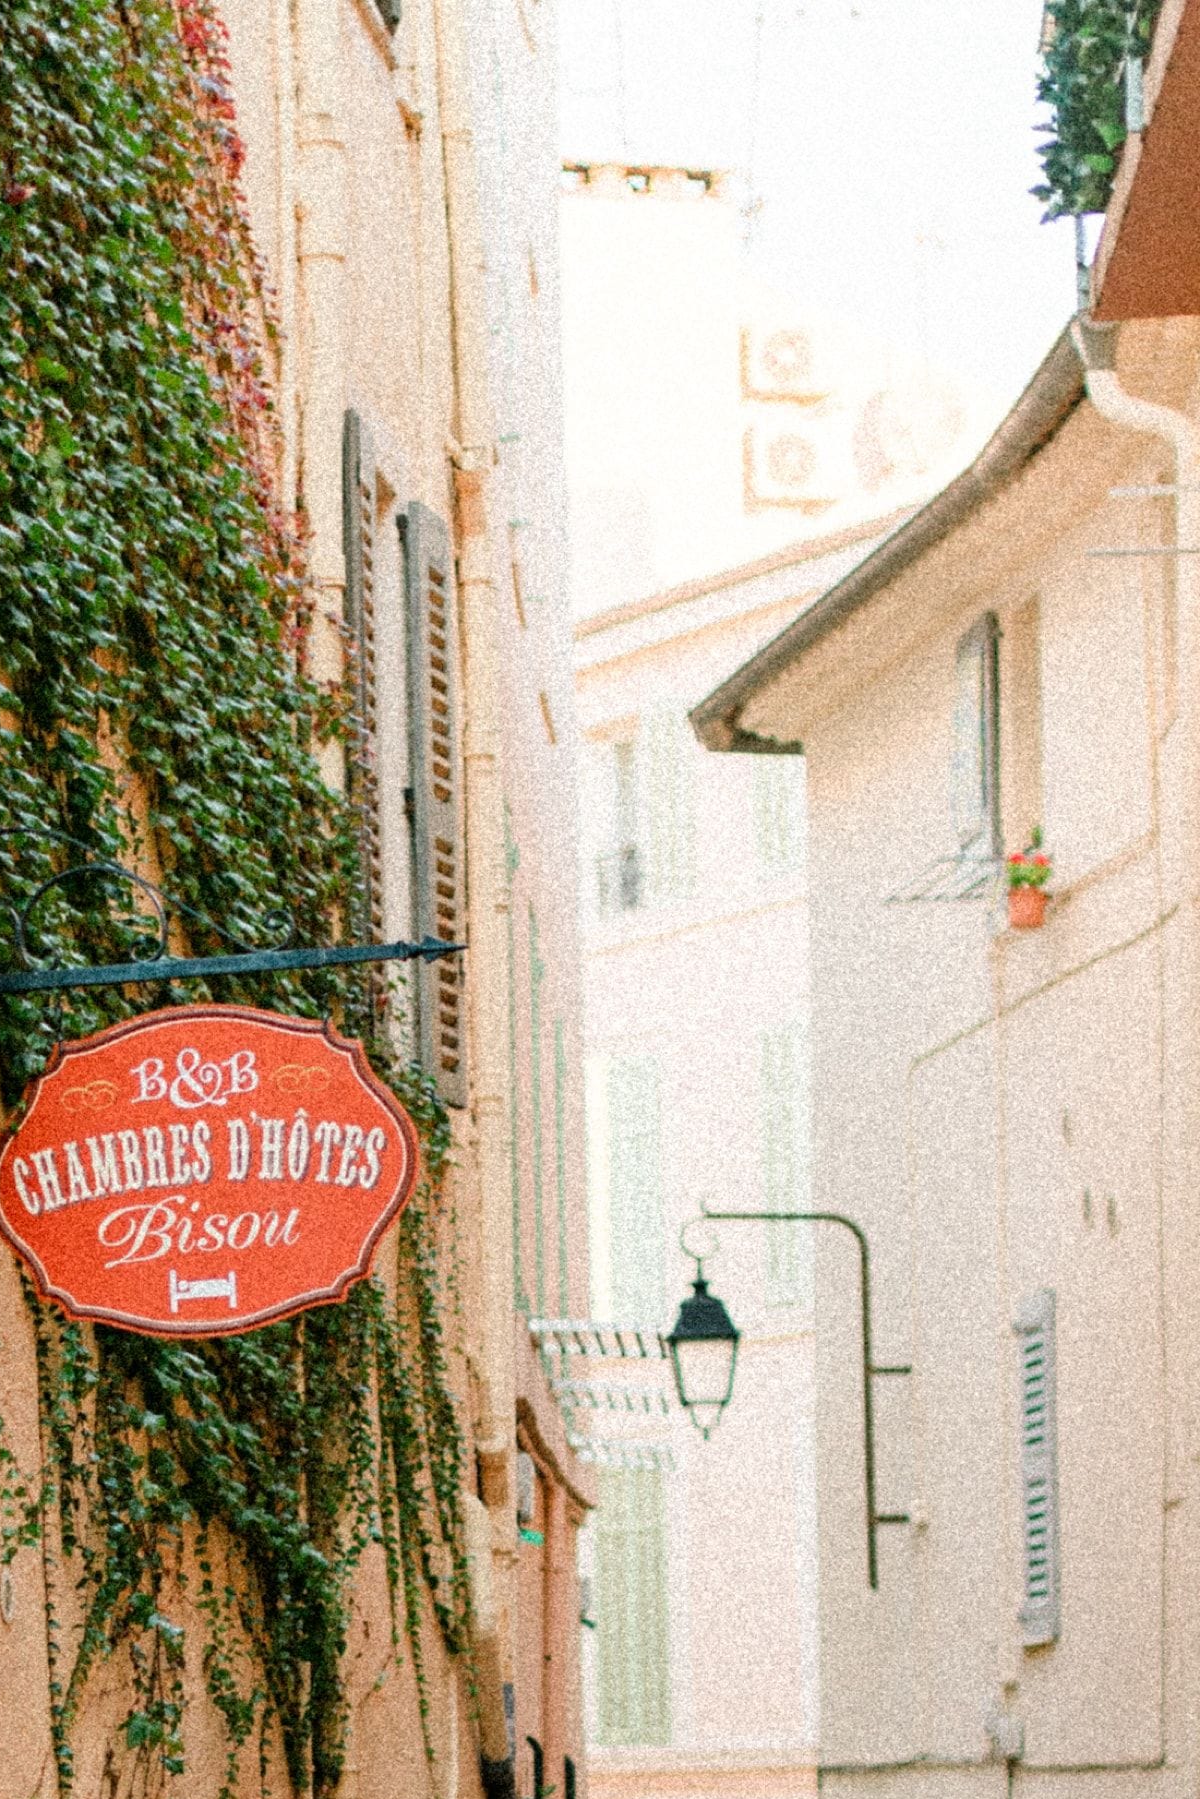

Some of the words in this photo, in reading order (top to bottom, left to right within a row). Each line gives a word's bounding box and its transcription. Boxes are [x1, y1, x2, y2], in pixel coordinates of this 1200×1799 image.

[129, 1046, 260, 1109] B&B
[12, 1119, 213, 1216] CHAMBRES
[226, 1107, 388, 1190] D'HÔTES
[98, 1194, 302, 1269] Bisou
